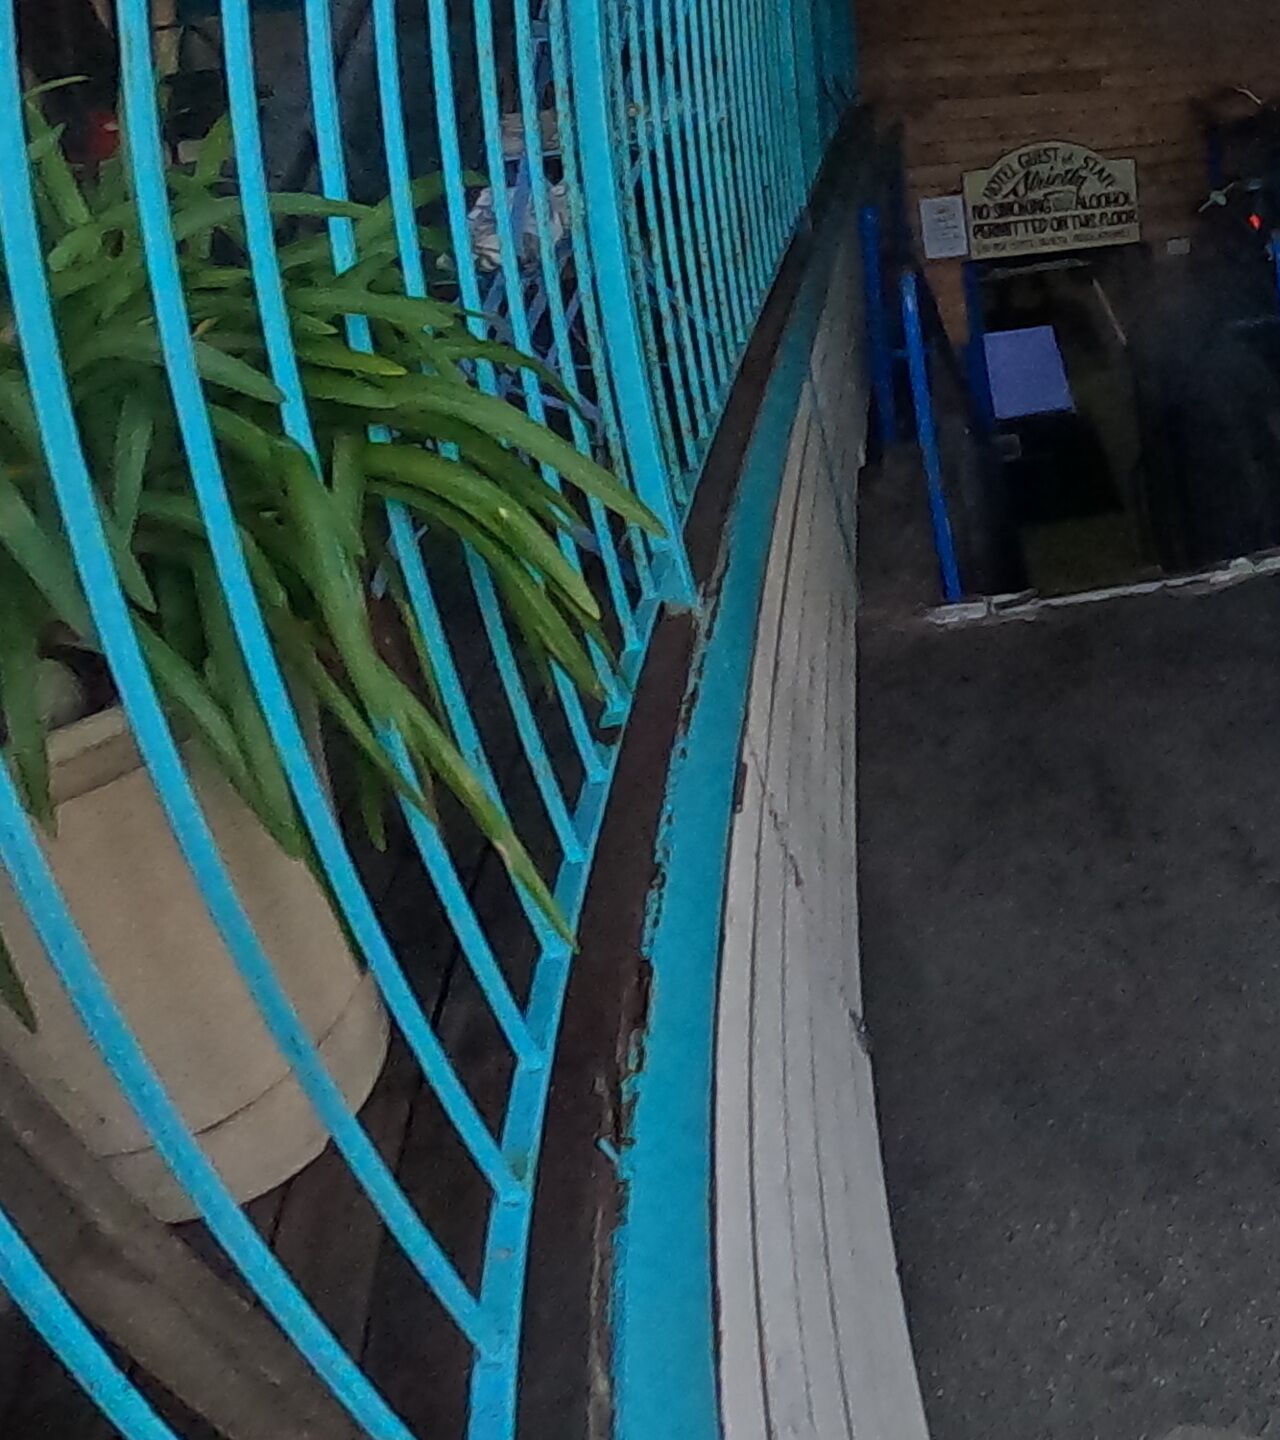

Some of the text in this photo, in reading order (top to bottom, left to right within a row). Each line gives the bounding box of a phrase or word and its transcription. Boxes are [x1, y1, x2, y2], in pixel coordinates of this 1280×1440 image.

[983, 163, 1018, 199] HOTEL
[1018, 147, 1060, 169] GUEST
[1082, 156, 1117, 188] STAFF
[1001, 165, 1088, 199] Strictly
[972, 191, 1134, 220] NO SMOKING ALCOHOL
[973, 217, 1049, 240] PERMITTED
[1050, 215, 1070, 232] ON
[1099, 209, 1138, 226] FLOOR
